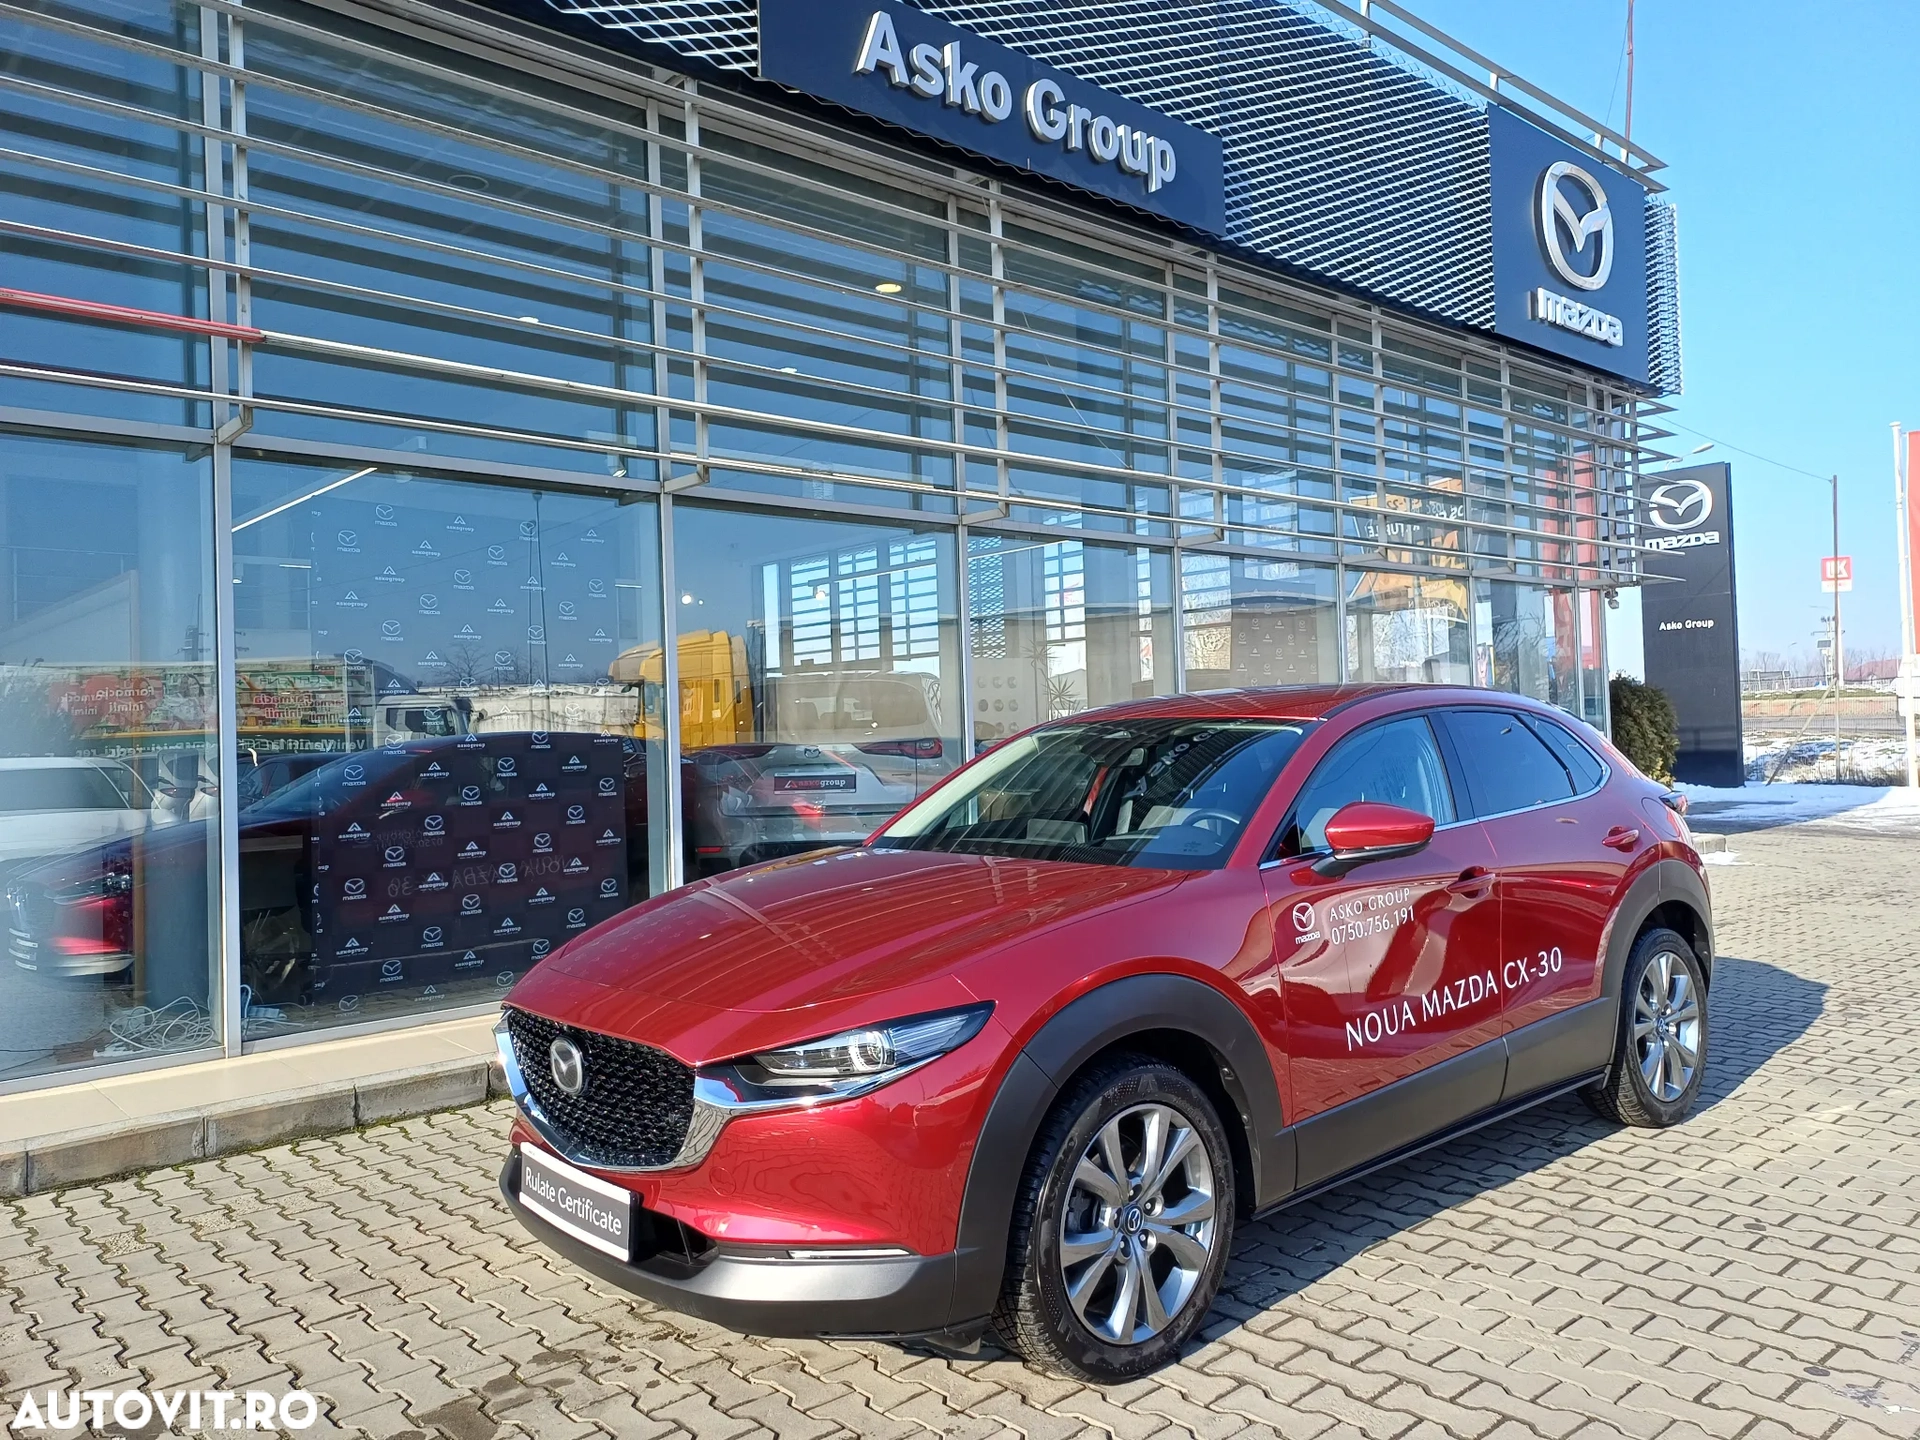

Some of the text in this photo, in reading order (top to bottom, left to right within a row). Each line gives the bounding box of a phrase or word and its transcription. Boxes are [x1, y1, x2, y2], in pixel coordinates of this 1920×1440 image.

[855, 10, 1177, 193] Asko Group
[1536, 287, 1624, 347] mazda
[1645, 531, 1720, 550] mazda
[1659, 619, 1714, 631] Asko Group
[1329, 887, 1411, 922] ASKO GROUP
[1295, 931, 1321, 944] mazda
[1331, 905, 1416, 945] 0750.756.191
[1345, 946, 1562, 1052] NOUA MAZDA CX-30
[525, 1166, 622, 1236] Rulate Certificate
